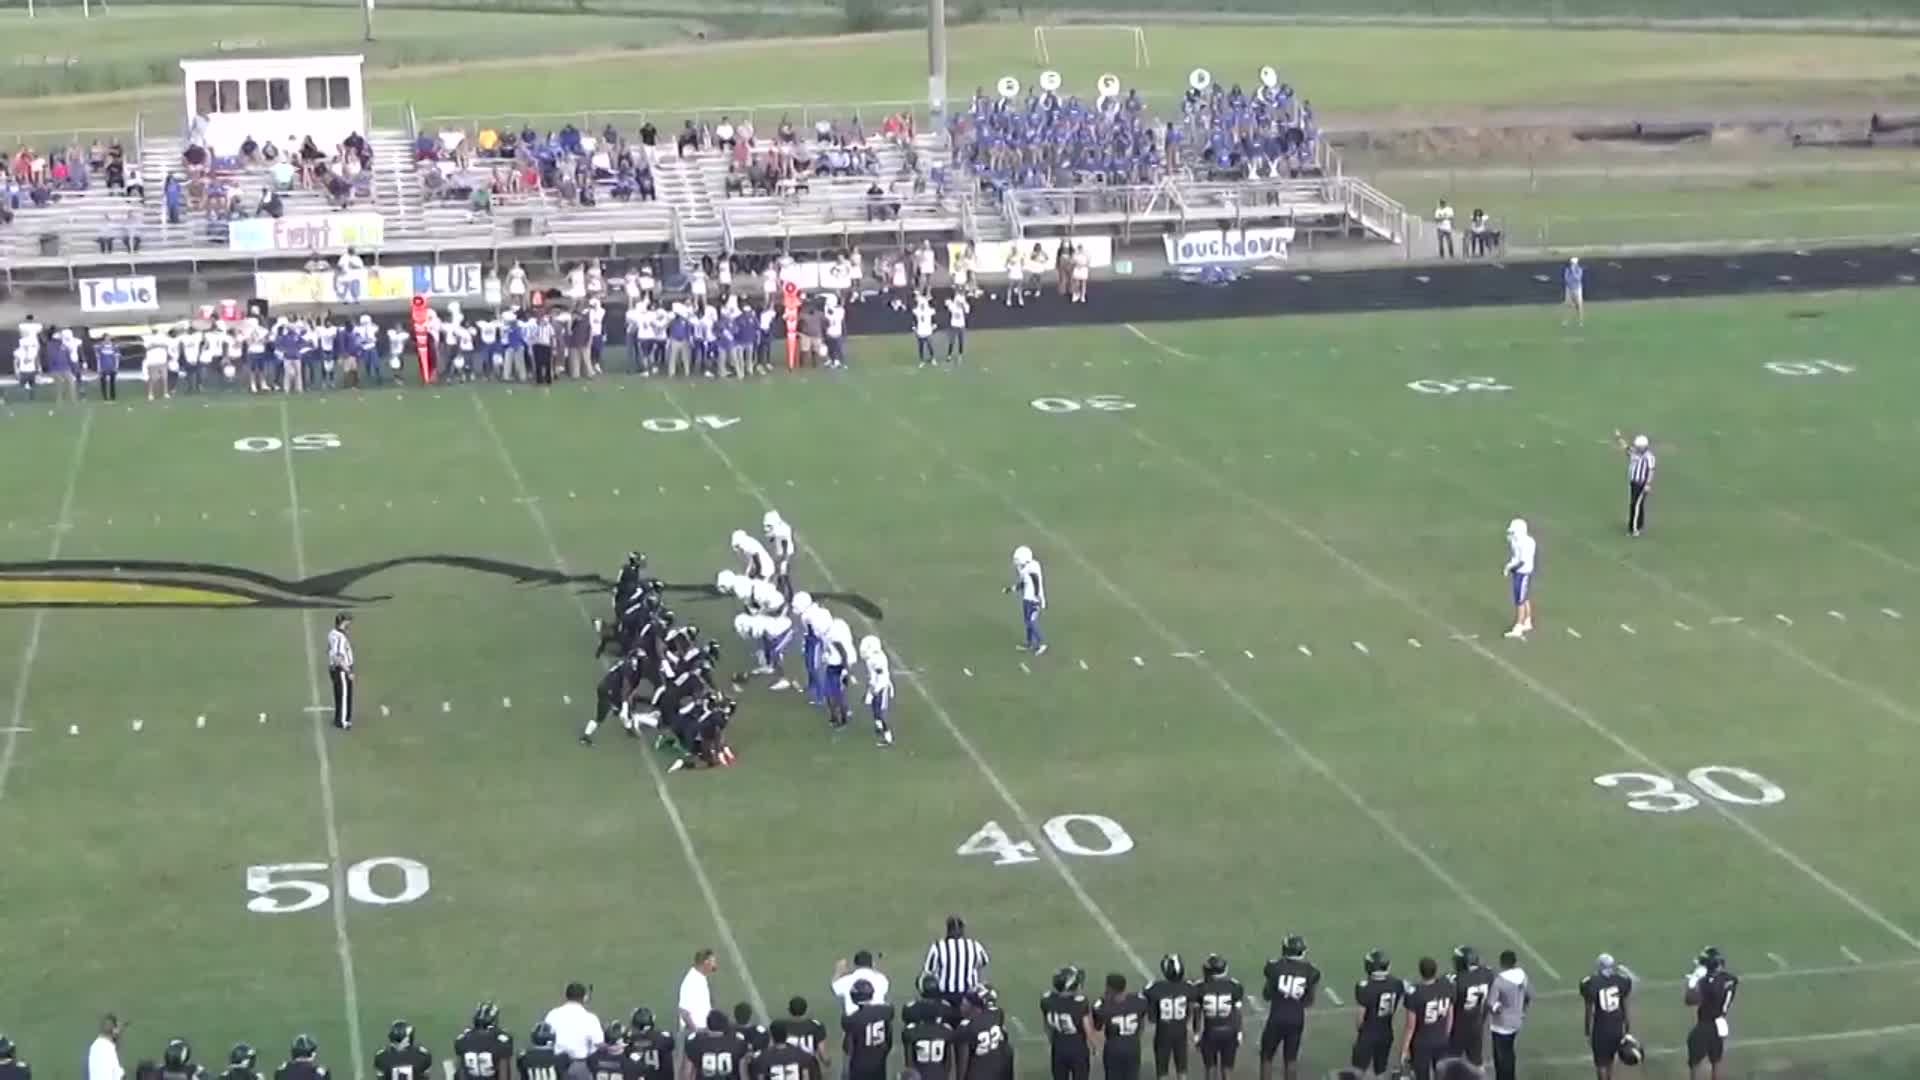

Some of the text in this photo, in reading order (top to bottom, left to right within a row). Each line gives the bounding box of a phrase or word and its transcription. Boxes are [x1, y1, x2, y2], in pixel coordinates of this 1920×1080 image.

[412, 264, 479, 294] BLUE
[641, 416, 741, 442] 40
[233, 433, 341, 452] 50
[1593, 766, 1785, 812] 30
[957, 813, 1134, 865] 40
[247, 857, 430, 913] 50
[1278, 974, 1307, 1000] 46
[1047, 1011, 1078, 1034] 43
[1424, 997, 1450, 1024] 54
[865, 1020, 885, 1046] 15
[1111, 1013, 1139, 1036] 75
[464, 1052, 494, 1076] 92
[702, 1052, 732, 1076] 90
